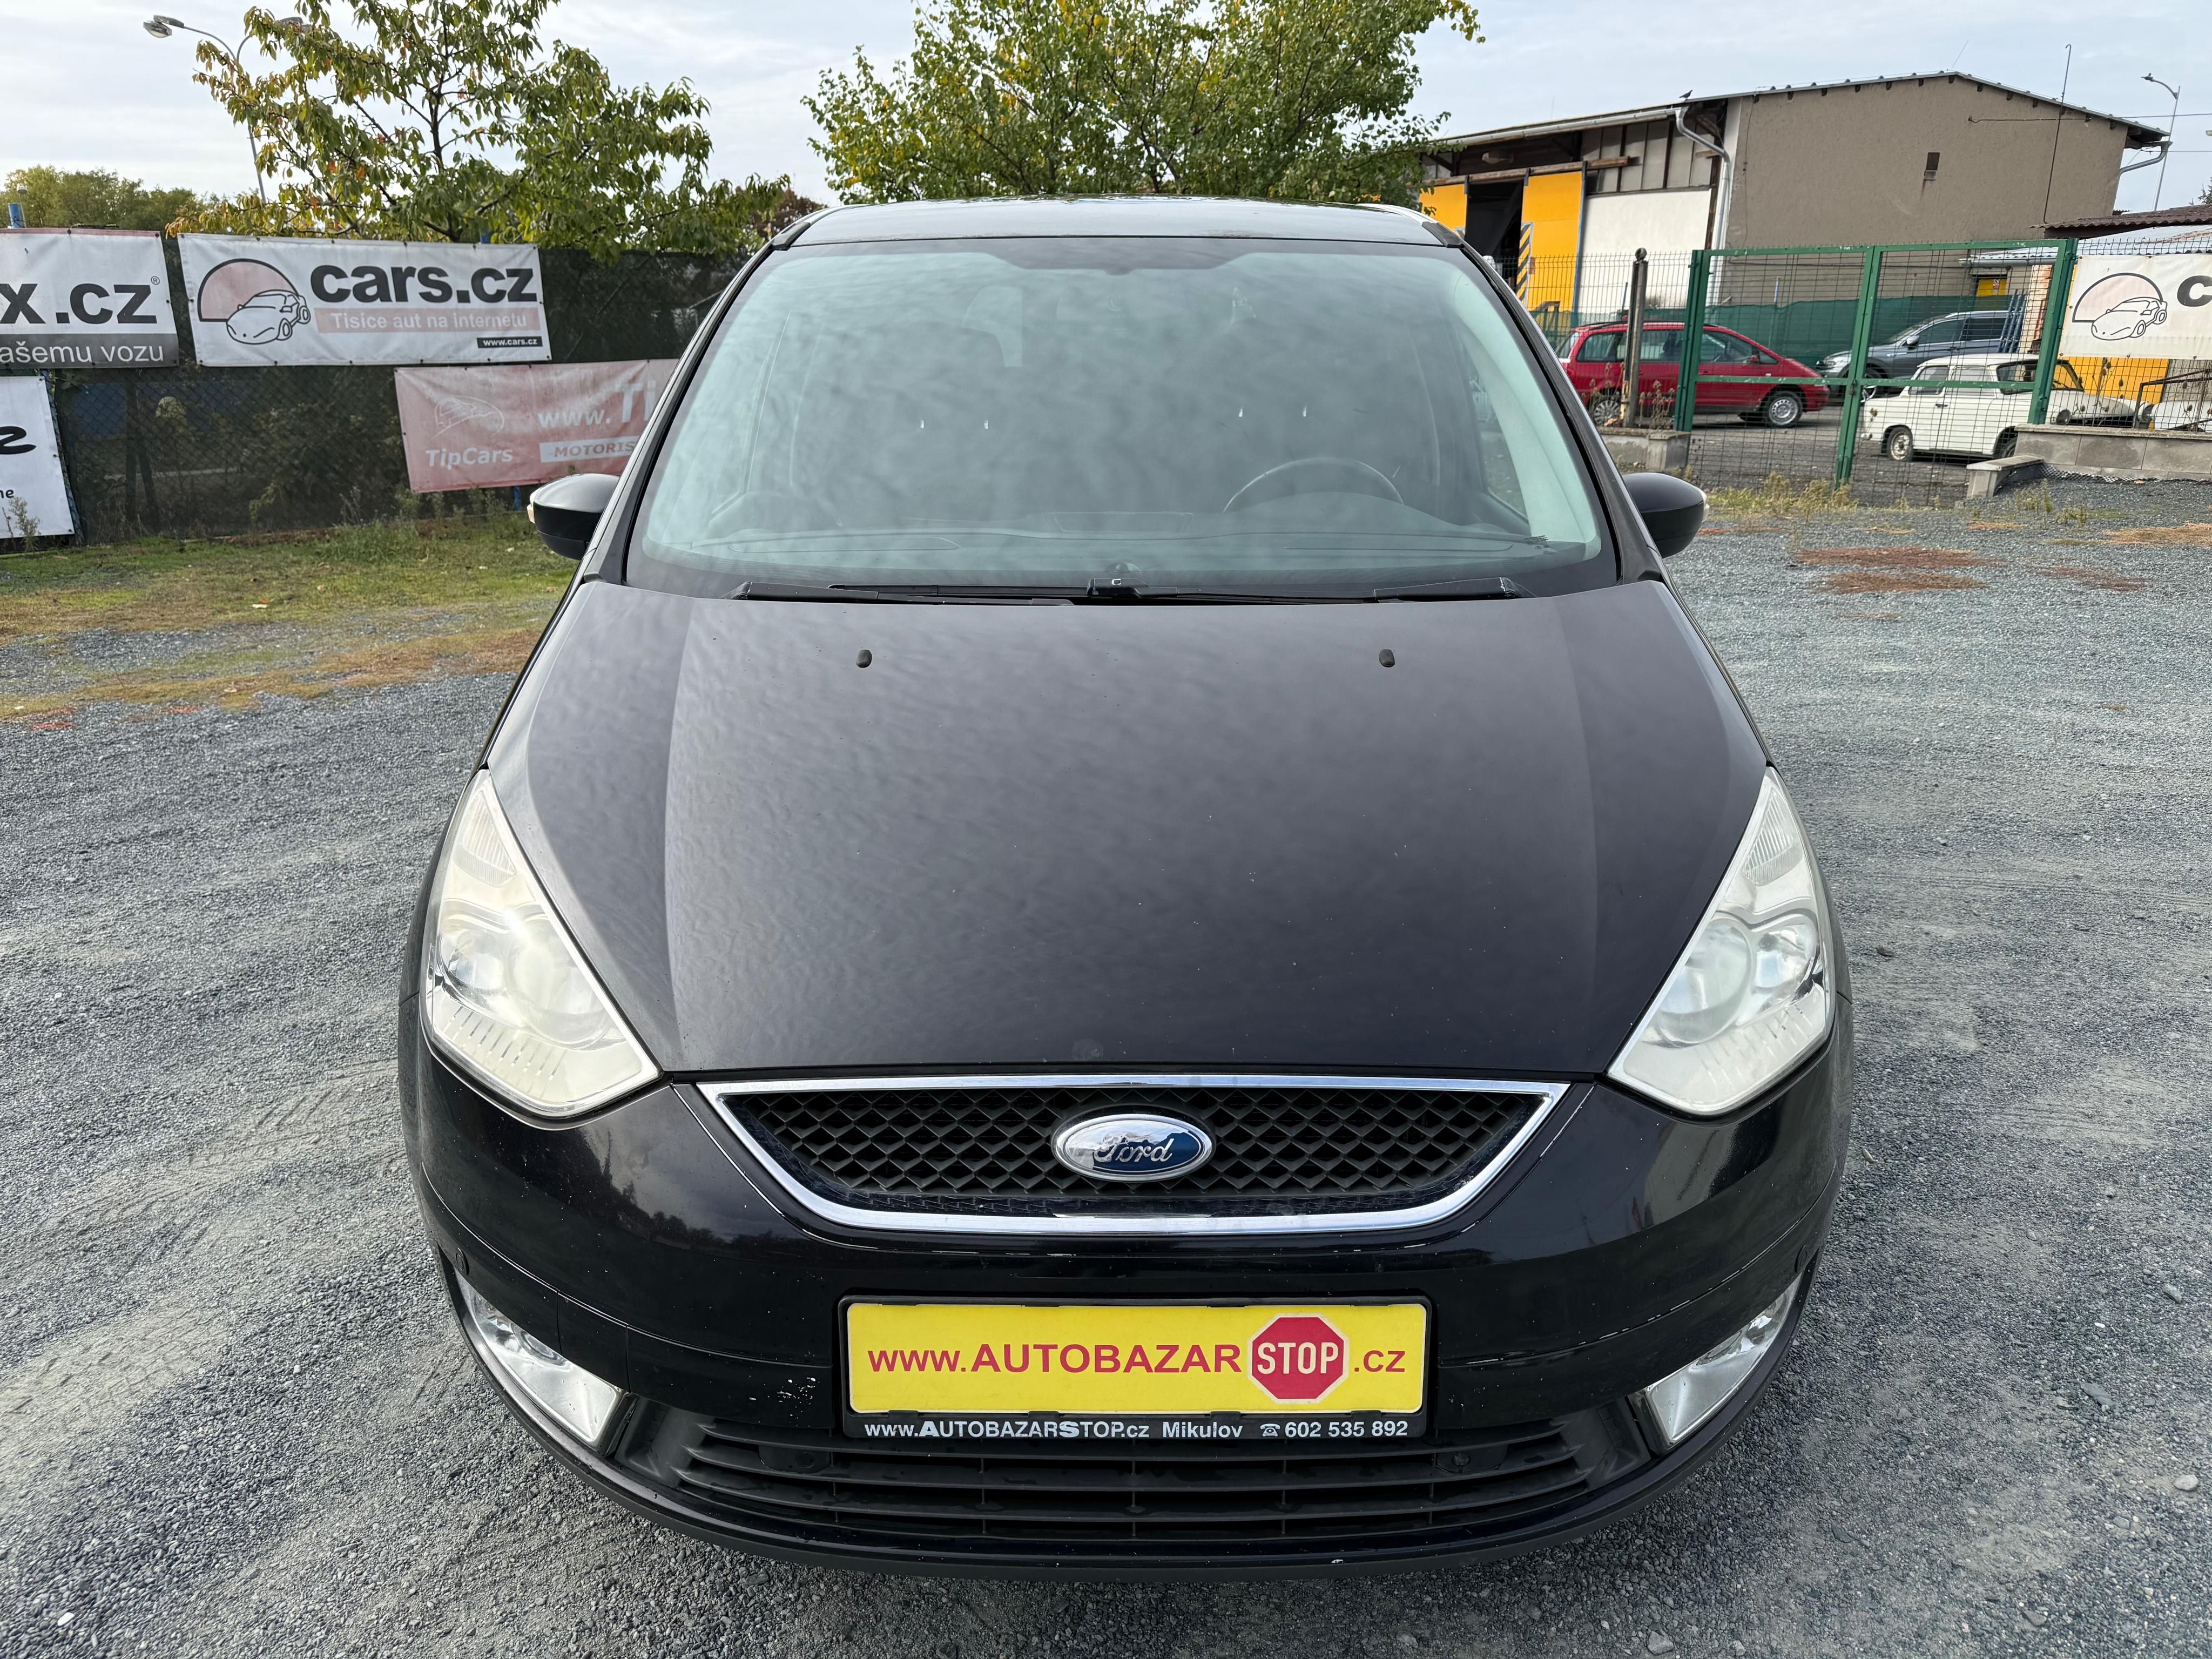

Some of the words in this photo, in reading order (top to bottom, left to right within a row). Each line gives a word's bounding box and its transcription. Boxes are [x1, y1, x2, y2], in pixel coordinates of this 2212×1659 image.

[311, 265, 537, 304] cars.cz
[2177, 275, 2212, 307] c
[393, 313, 421, 328] aut
[427, 314, 448, 328] na
[453, 312, 527, 328] internetu
[0, 341, 92, 363] ašemu
[100, 345, 164, 362] vozu
[426, 448, 513, 470] TipCars
[554, 441, 635, 457] MOTORIS
[1093, 1133, 1175, 1163] Ford
[1257, 1341, 1339, 1375] STOP
[865, 1421, 1149, 1438] www.AUTOBAZARSTOP.cz
[1163, 1421, 1243, 1438] Mikulov
[1285, 1421, 1321, 1438] 602
[1328, 1421, 1364, 1438] 535
[1371, 1420, 1408, 1437] 892
